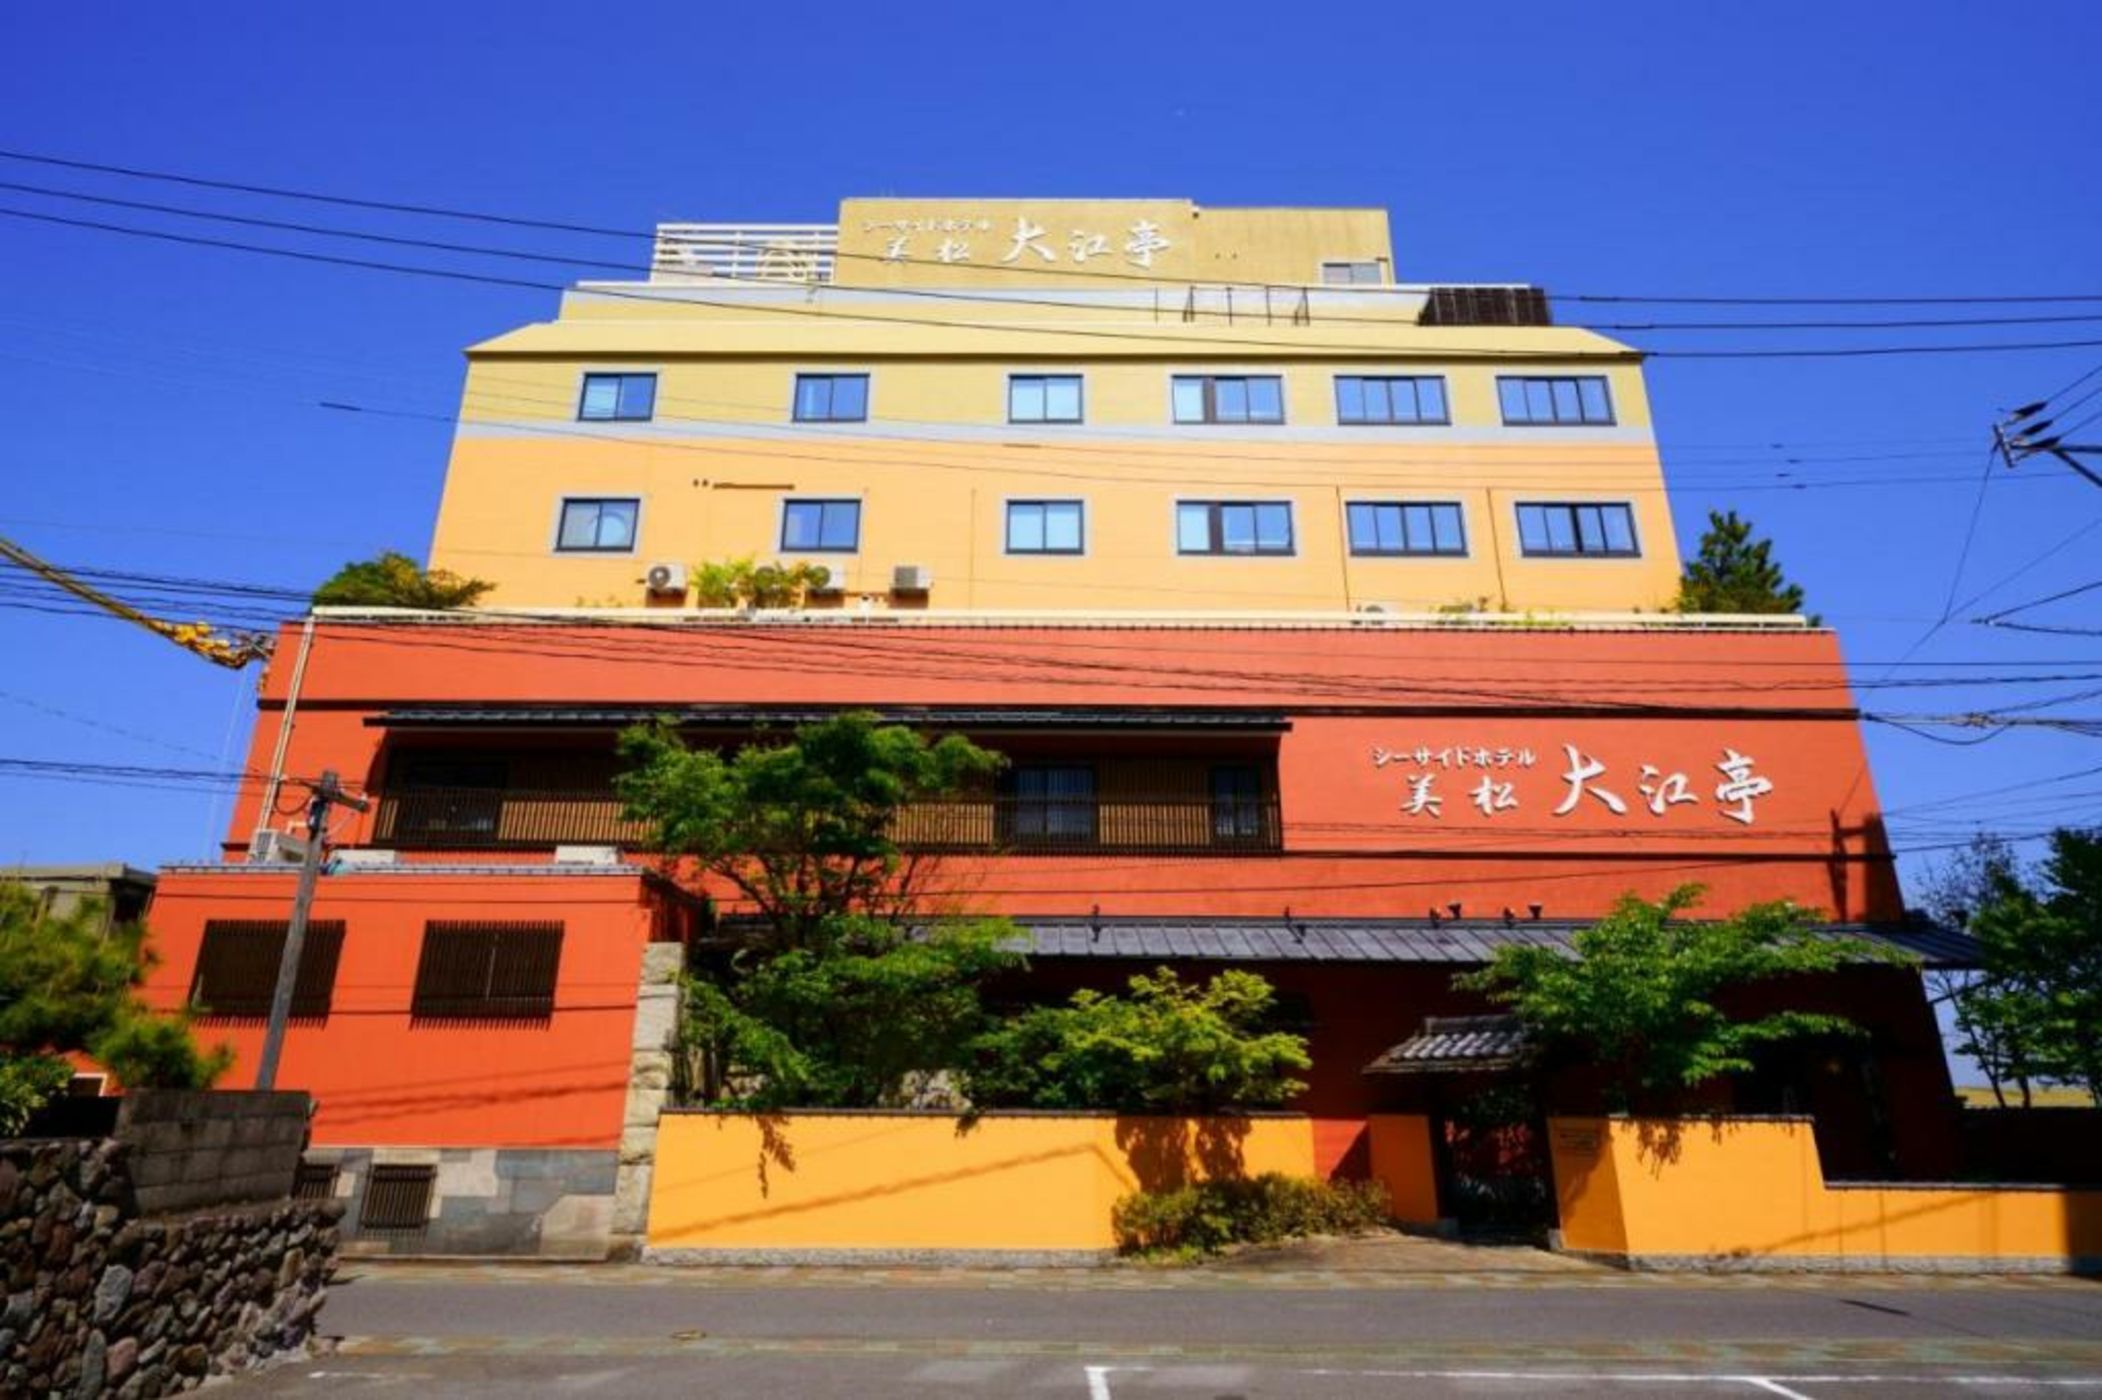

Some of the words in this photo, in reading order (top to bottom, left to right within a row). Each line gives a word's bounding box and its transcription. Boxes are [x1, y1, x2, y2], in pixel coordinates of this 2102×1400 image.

[1002, 217, 1171, 270] 大江亭
[1372, 746, 1537, 768] シーサイドホテル
[1400, 773, 1518, 817] 美松
[1551, 743, 1774, 825] 大江亭
